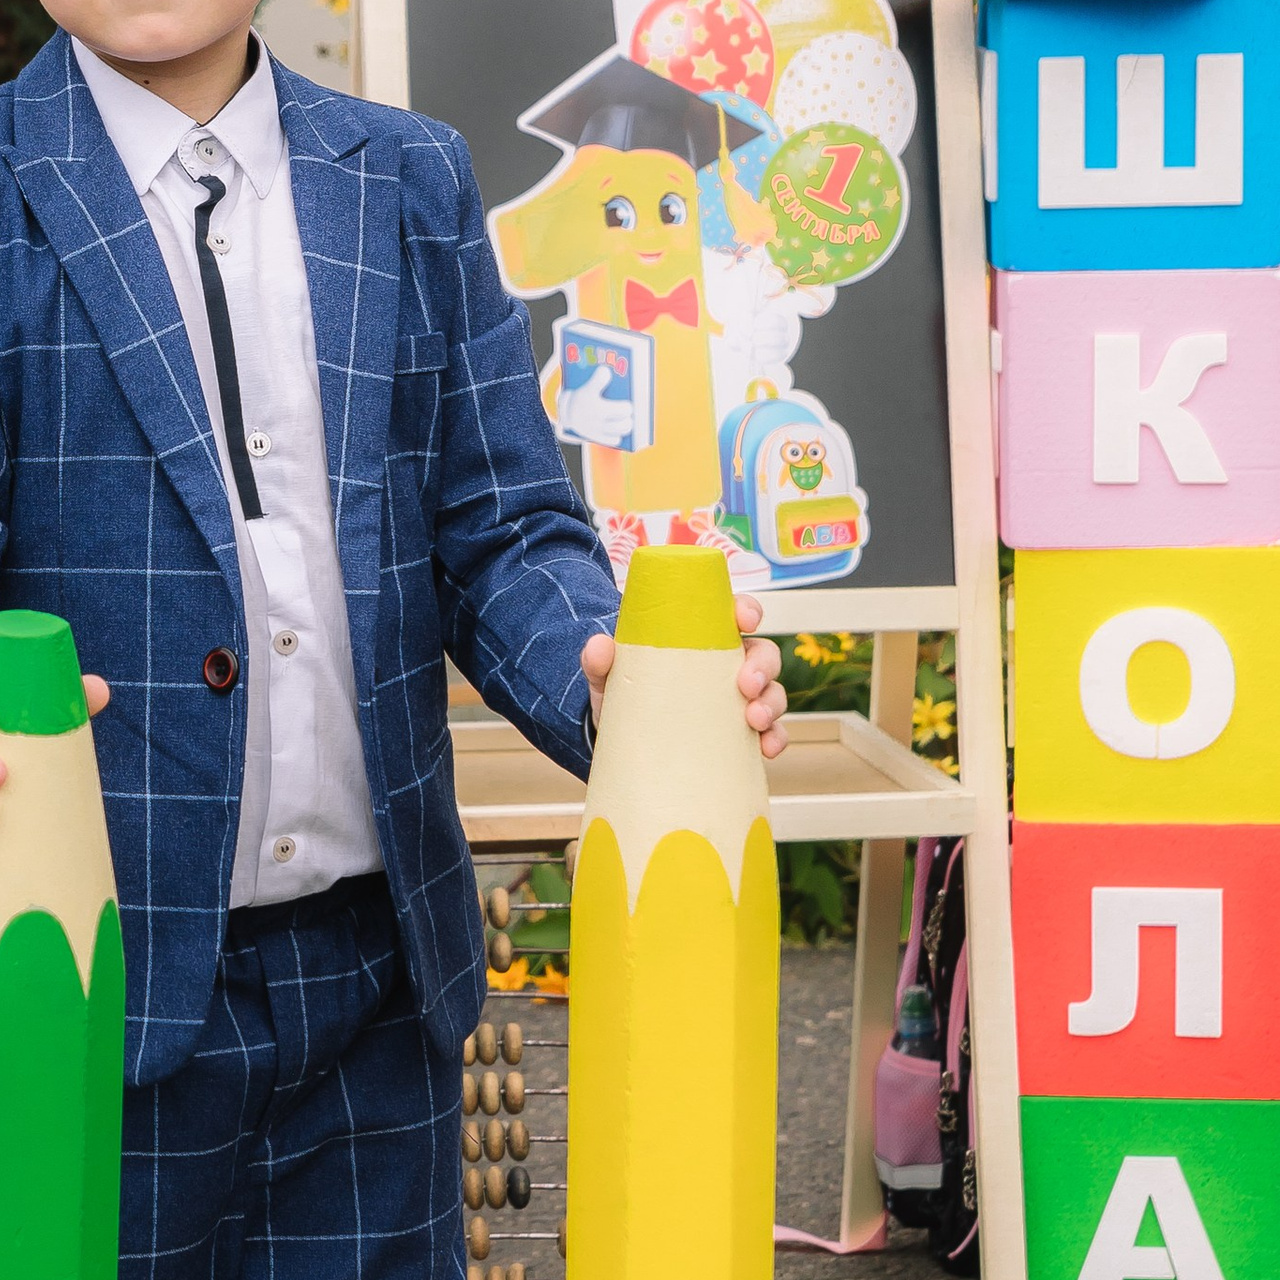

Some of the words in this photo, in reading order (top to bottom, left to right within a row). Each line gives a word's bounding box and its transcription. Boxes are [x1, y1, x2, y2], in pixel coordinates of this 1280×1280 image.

[771, 173, 882, 246] СЕНТЯБРЯ
[804, 142, 865, 216] 1
[800, 522, 852, 548] АБВ
